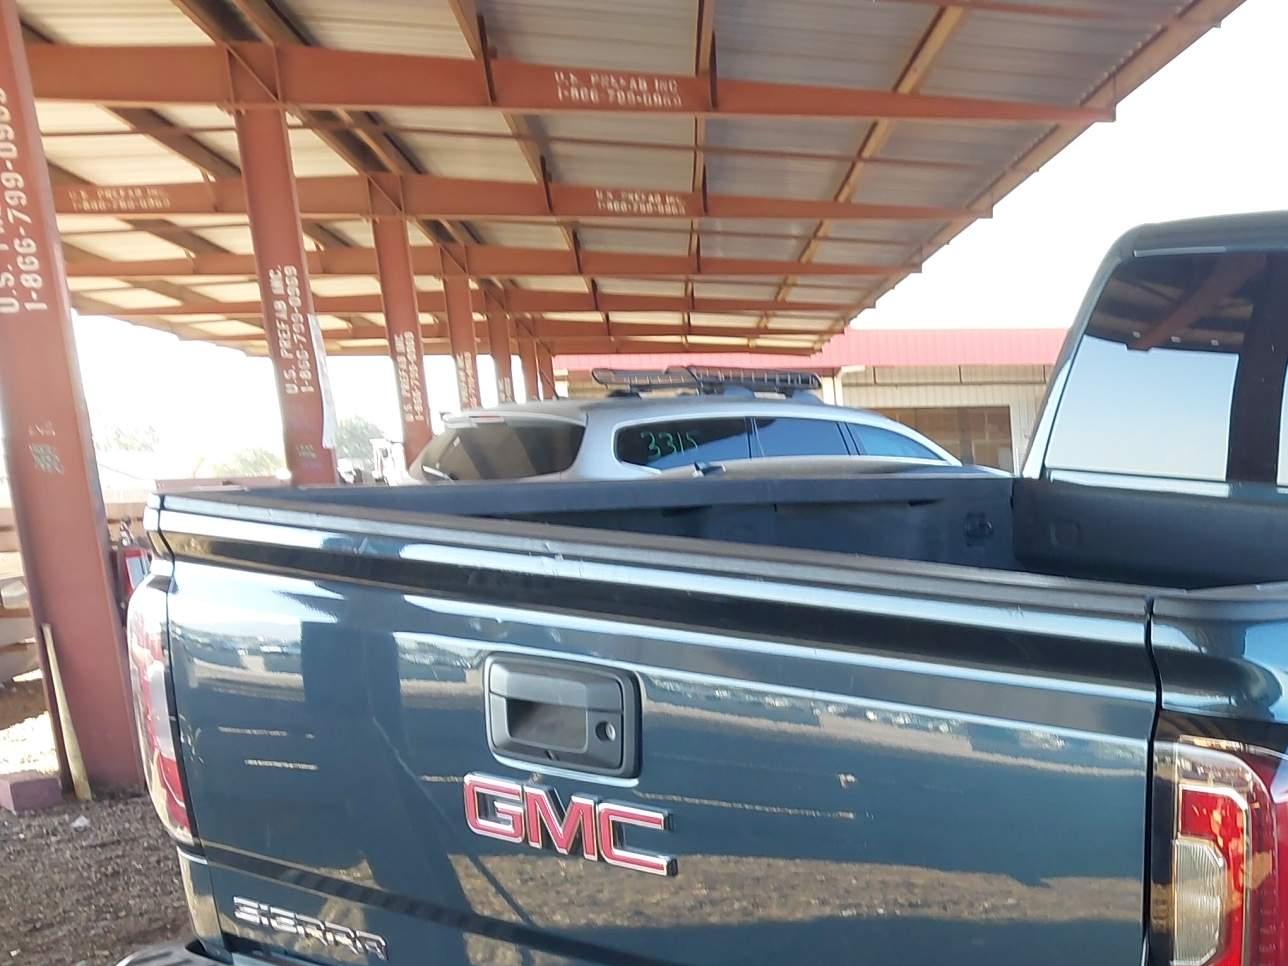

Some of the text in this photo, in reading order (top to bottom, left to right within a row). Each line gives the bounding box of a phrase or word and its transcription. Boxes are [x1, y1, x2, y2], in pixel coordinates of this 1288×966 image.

[0, 87, 48, 312] 1-866-799-09
[273, 299, 294, 359] PREFAB
[463, 772, 678, 877] GMC
[233, 896, 389, 961] SIERRA
